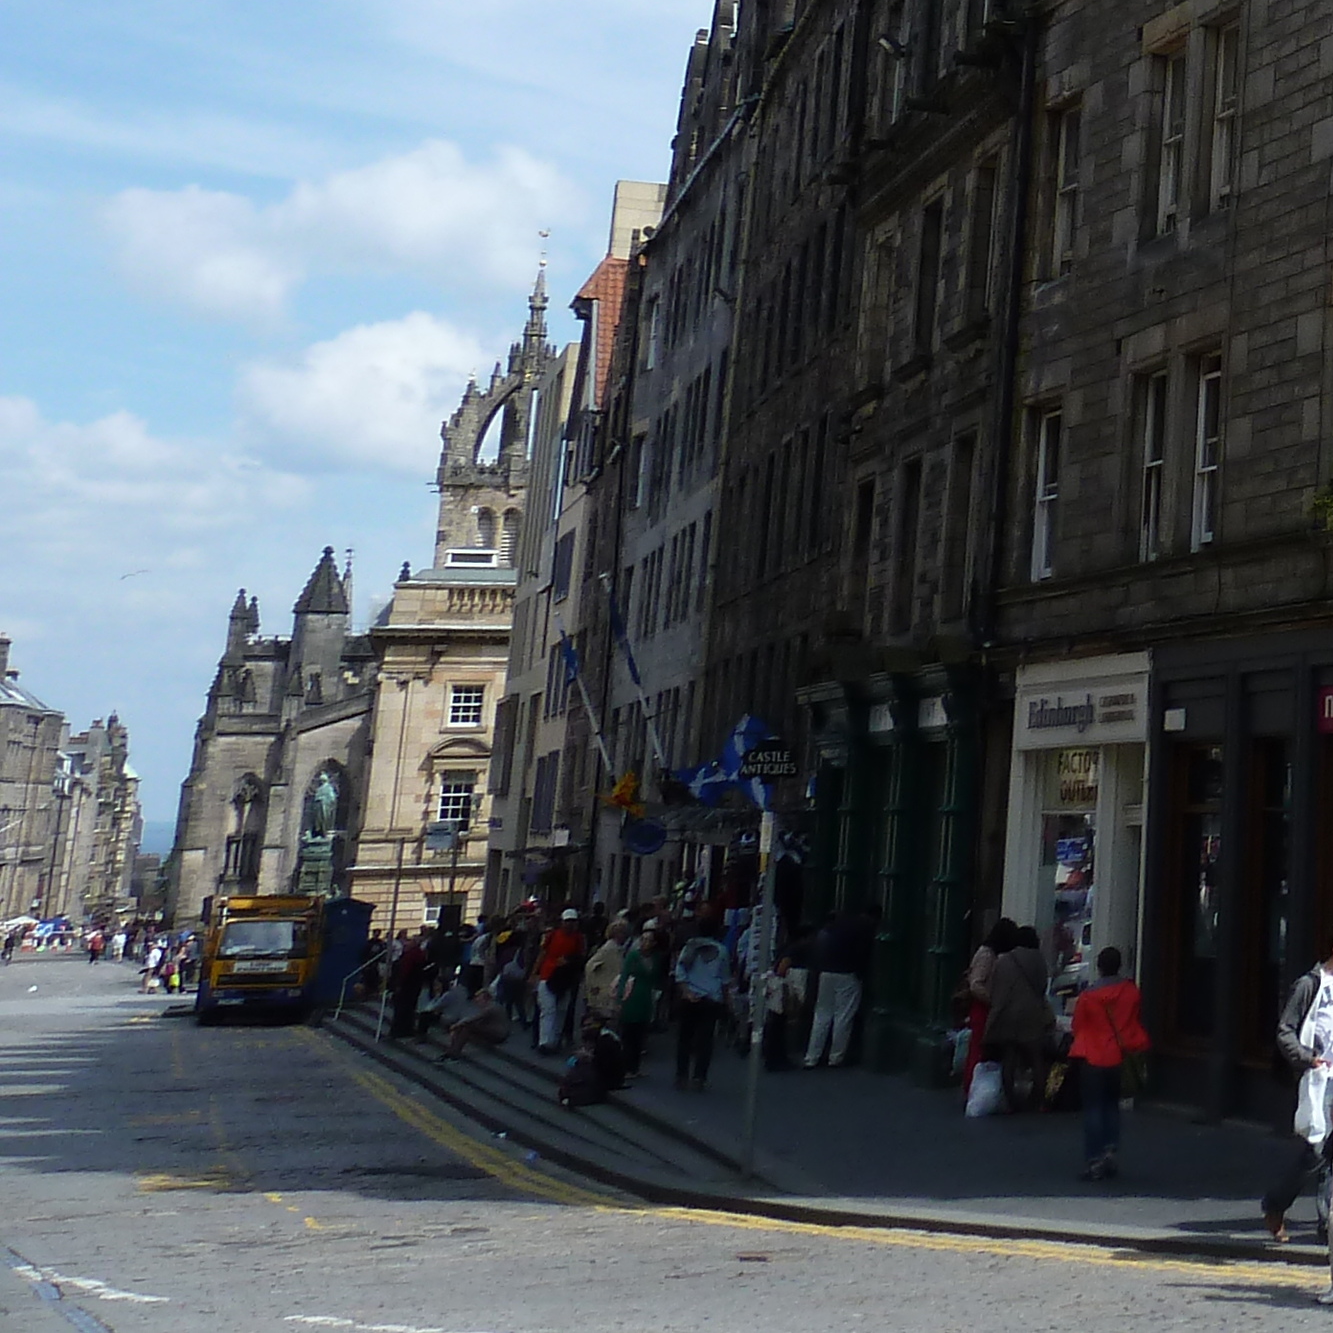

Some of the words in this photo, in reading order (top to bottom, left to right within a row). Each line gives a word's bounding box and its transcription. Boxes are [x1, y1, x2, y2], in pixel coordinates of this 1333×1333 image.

[1027, 693, 1095, 733] Edinburgh
[747, 750, 790, 762] CASTLE
[740, 762, 797, 775] ANTIQUES
